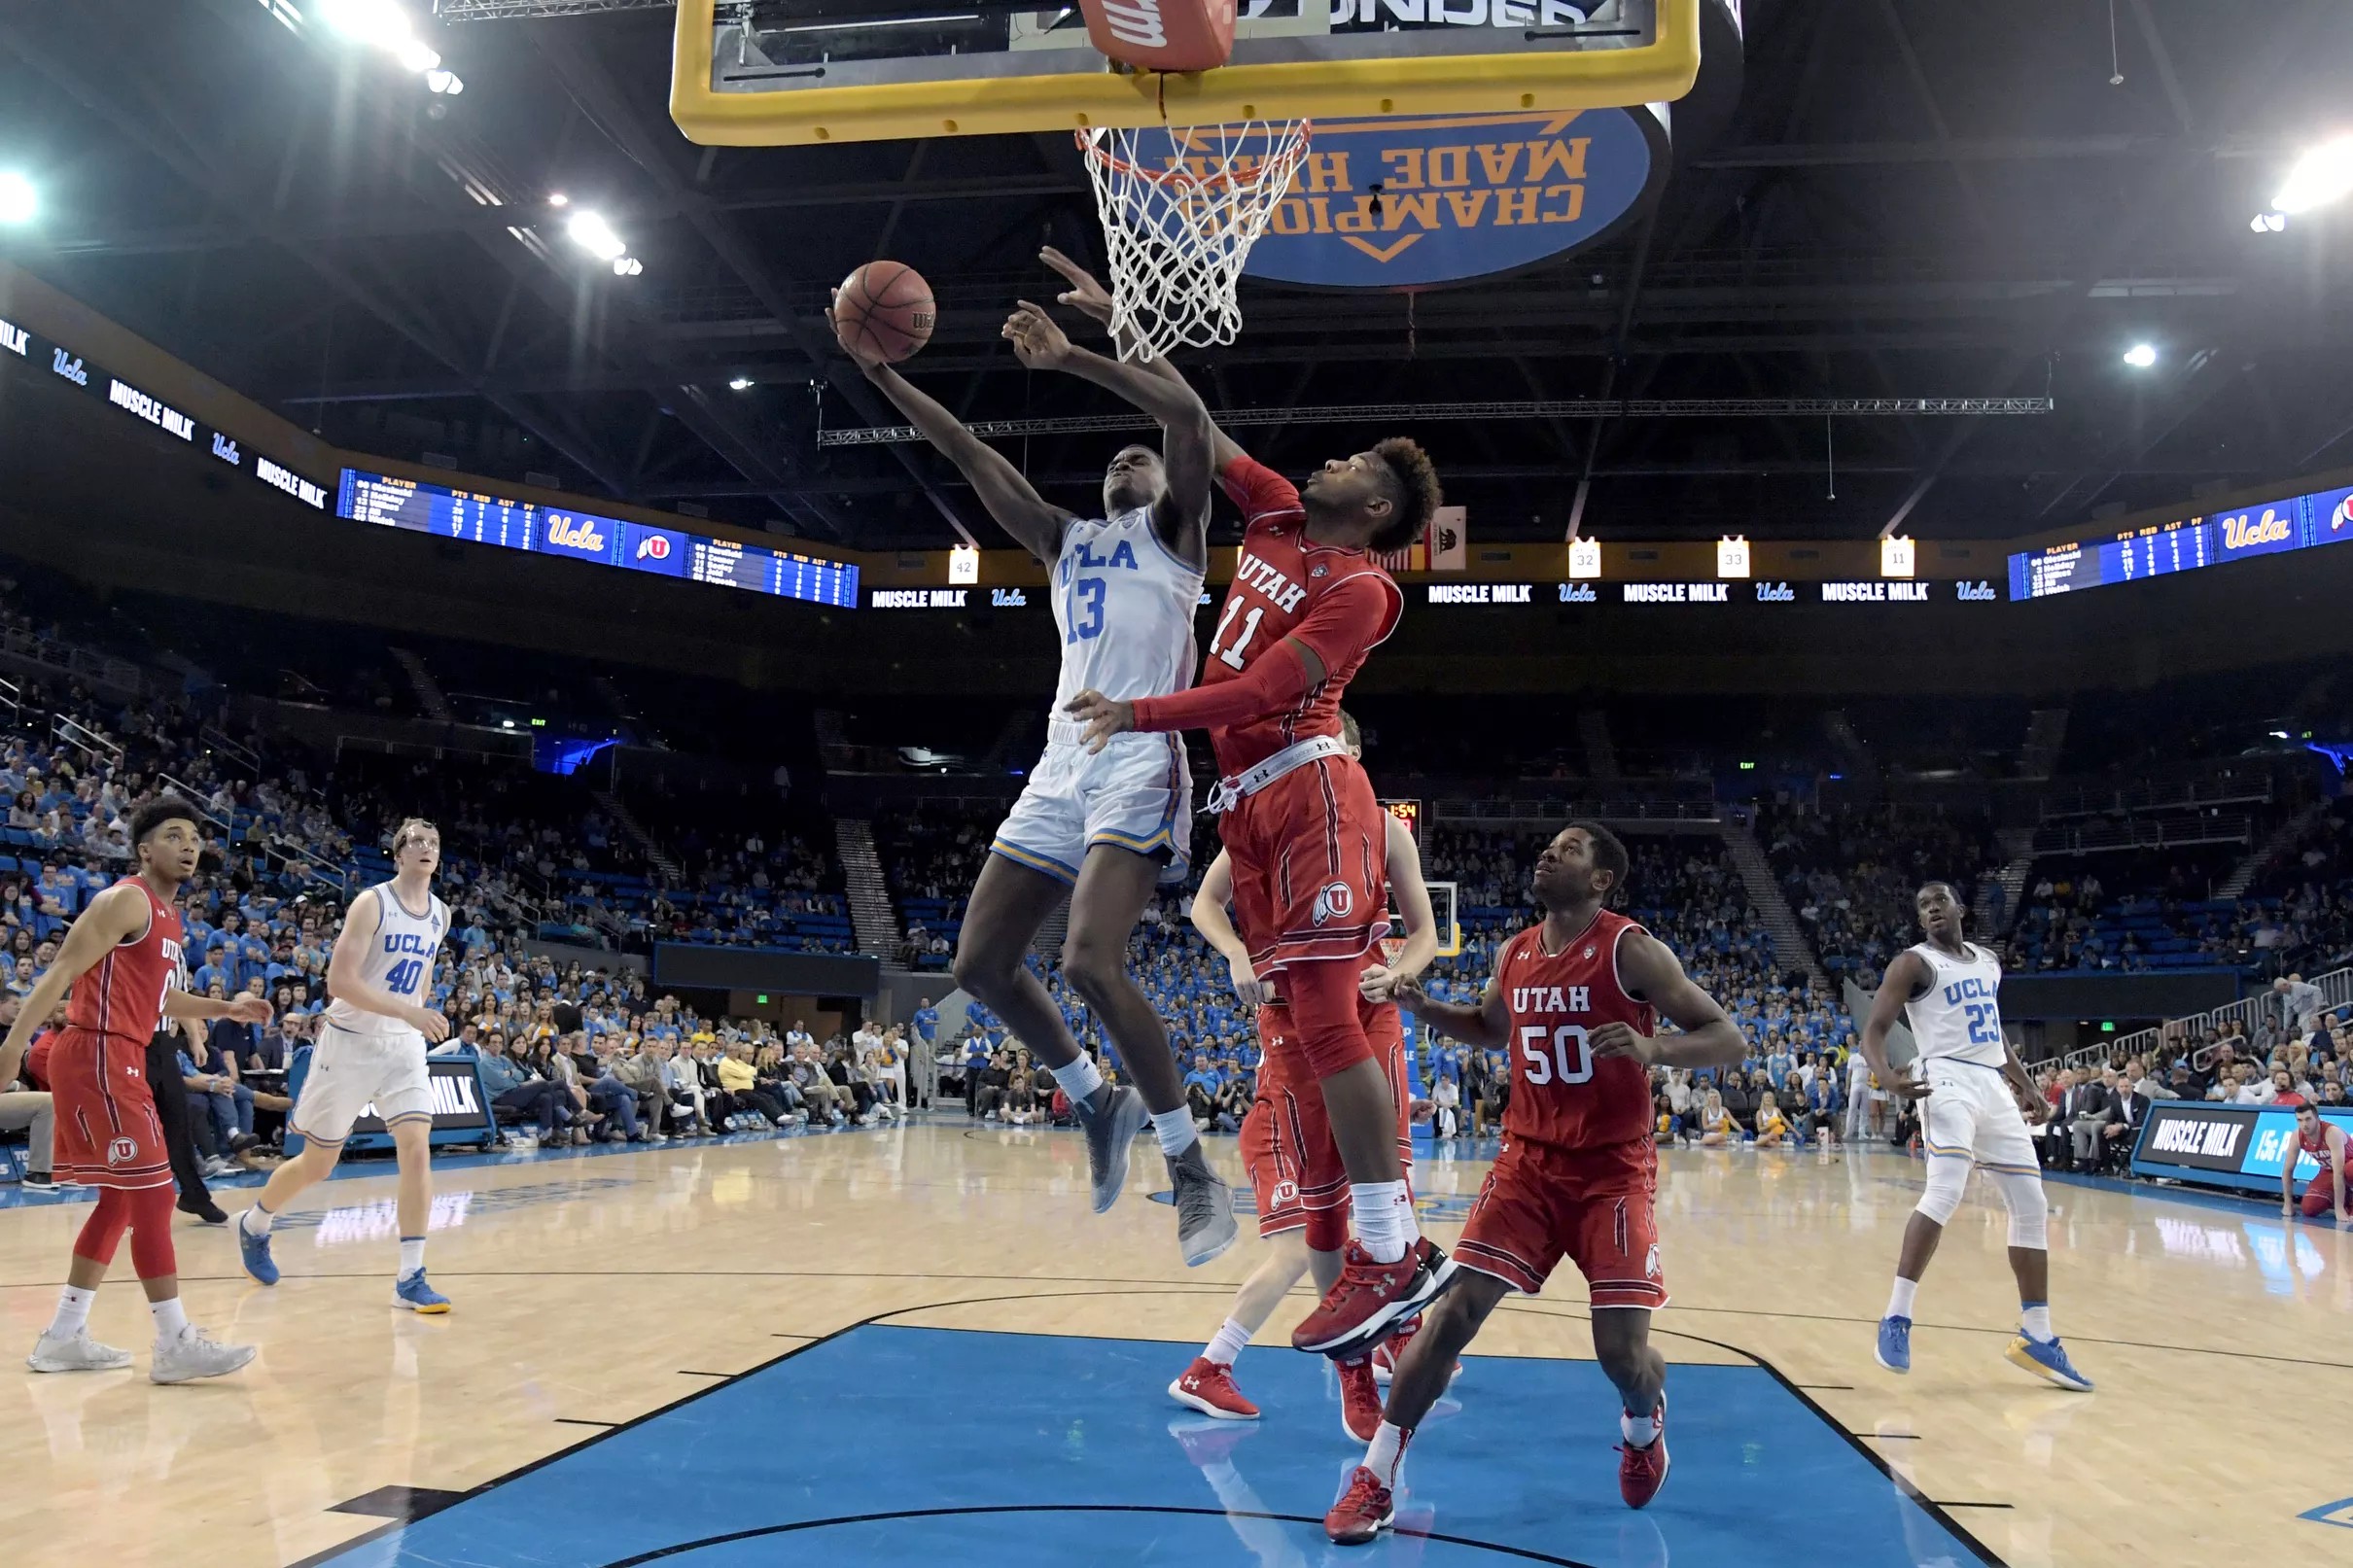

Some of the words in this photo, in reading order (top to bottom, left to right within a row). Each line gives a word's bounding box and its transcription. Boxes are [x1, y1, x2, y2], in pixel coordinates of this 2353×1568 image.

[1382, 138, 1592, 191] MADE
[109, 378, 160, 425] MUSCLE
[161, 406, 194, 441] MILK
[256, 457, 299, 497] MUSCLE
[299, 478, 328, 509] MILK
[382, 476, 416, 490] PLAYER
[498, 499, 515, 507] AST
[547, 514, 605, 552] Ucla
[2047, 542, 2079, 555] PLAYER
[2164, 521, 2182, 531] AST
[2222, 508, 2291, 549] Ucla
[713, 539, 742, 550] PLAYER
[1893, 553, 1905, 564] 11
[956, 561, 971, 574] 42
[1577, 554, 1594, 566] 32
[1725, 554, 1742, 565] 33
[992, 588, 1027, 607] Ucla
[1236, 553, 1308, 615] UTAH
[1428, 585, 1490, 603] MUSCLE
[1493, 585, 1531, 603] MILK
[1559, 582, 1597, 603] Ucla
[1624, 584, 1685, 602] MUSCLE
[1688, 583, 1728, 602] MILK
[1756, 581, 1795, 602] Ucla
[1822, 582, 1884, 602] MUSCLE
[1887, 582, 1928, 602] MILK
[1955, 580, 1996, 601] Ucla
[872, 590, 929, 609] MUSCLE
[931, 590, 966, 608] MILK
[1210, 594, 1265, 672] 11
[1329, 889, 1349, 912] U
[384, 933, 436, 961] UCLA
[385, 958, 424, 995] 40
[1512, 986, 1591, 1014] UTAH
[1964, 1002, 2000, 1044] 23
[1518, 1024, 1595, 1085] 50
[428, 1075, 479, 1115] MILK
[2152, 1119, 2208, 1155] MUSCLE
[2200, 1122, 2242, 1158] MILK
